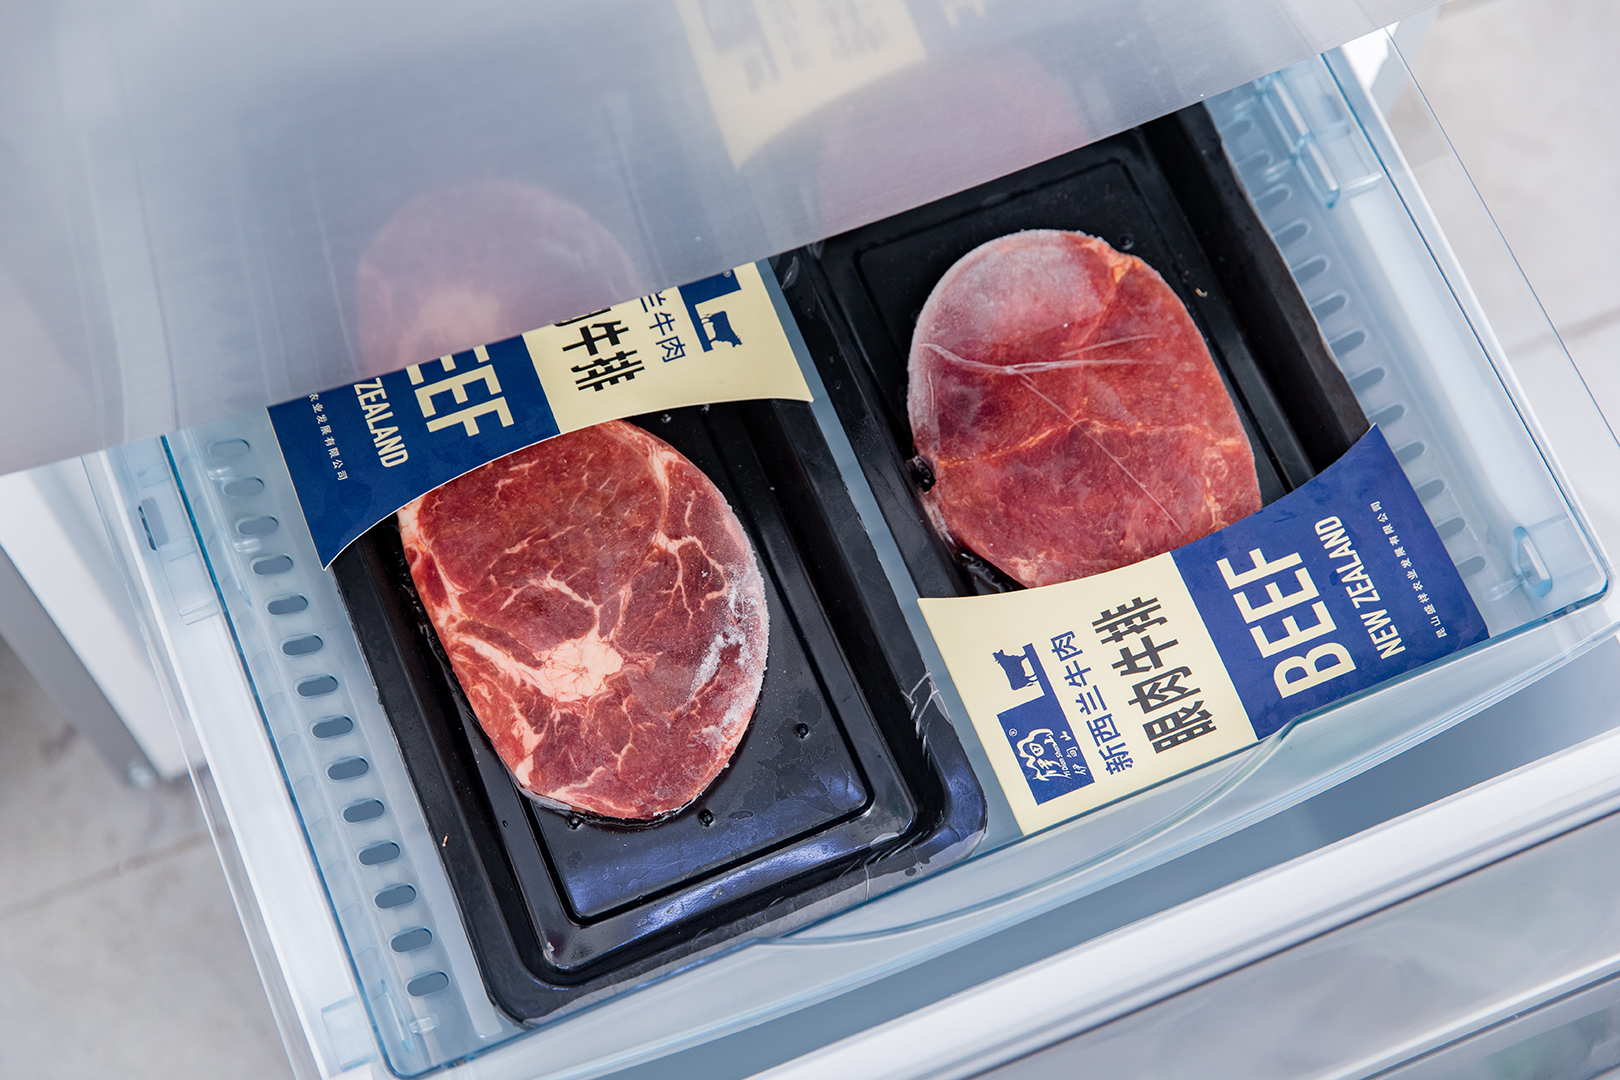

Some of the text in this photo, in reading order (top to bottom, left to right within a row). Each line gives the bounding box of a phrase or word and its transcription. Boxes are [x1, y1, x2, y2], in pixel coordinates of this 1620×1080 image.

[554, 307, 645, 392] 牛排
[354, 377, 409, 468] ZEALAND
[1216, 548, 1357, 699] BEEF
[1314, 515, 1406, 660] NEW ZEALAND
[1050, 631, 1134, 775] 新西兰牛肉
[1091, 596, 1218, 755] 眼肉牛排
